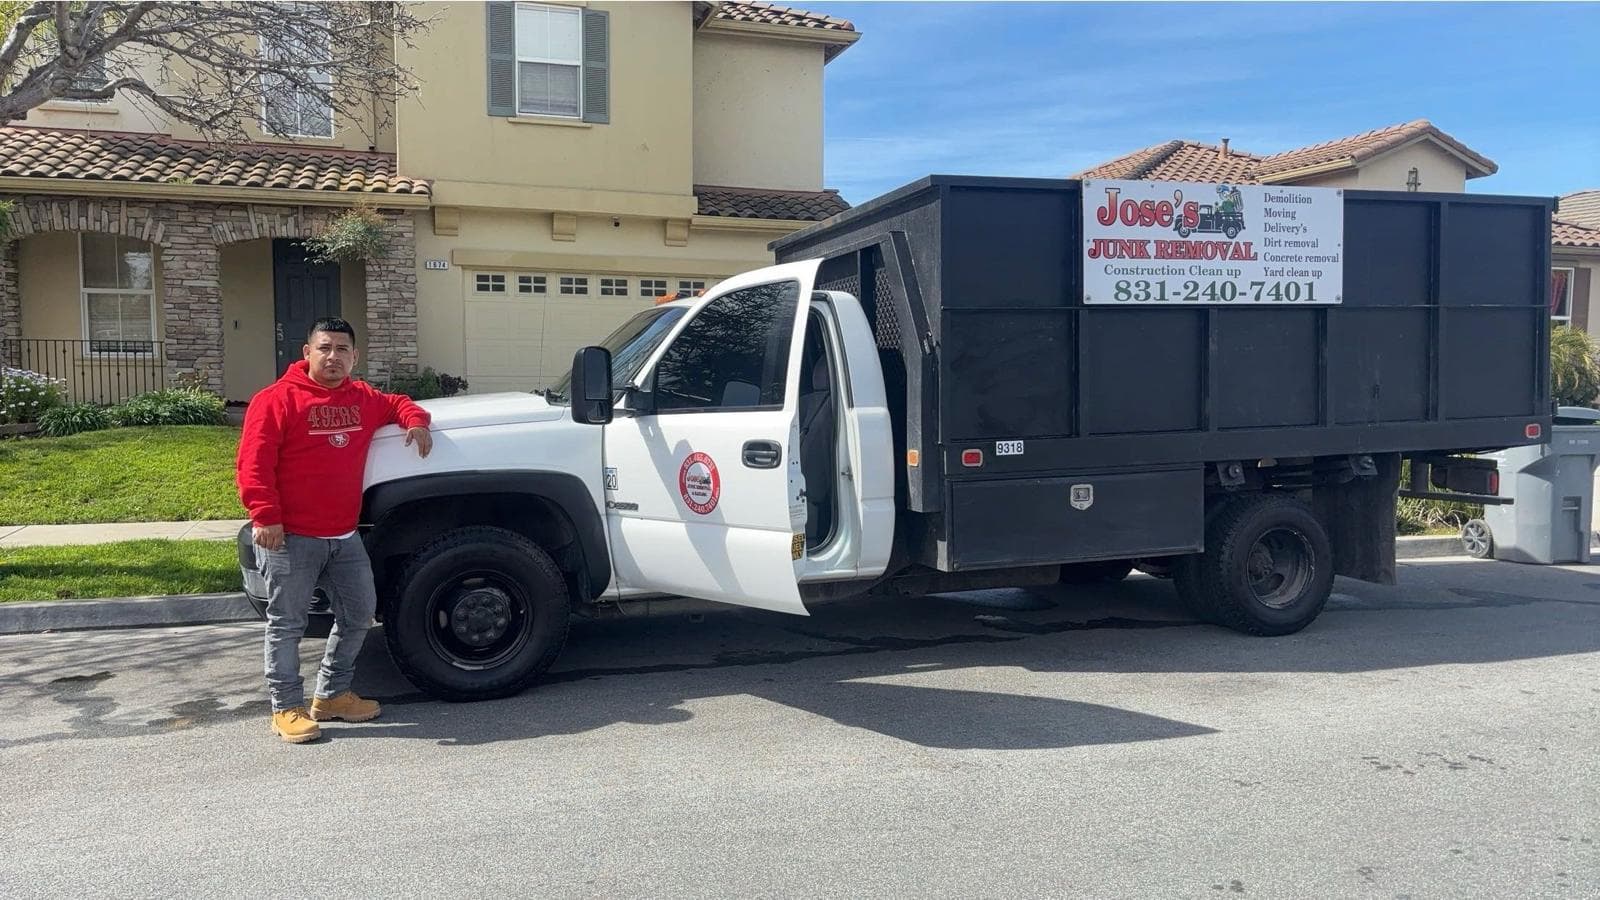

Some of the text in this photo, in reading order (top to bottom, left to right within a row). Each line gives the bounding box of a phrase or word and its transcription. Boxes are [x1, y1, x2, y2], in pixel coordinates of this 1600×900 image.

[1264, 193, 1312, 204] Demolition
[1097, 188, 1200, 228] Jose's
[1264, 208, 1297, 220] Moving
[1264, 222, 1307, 235] Delivery's
[1264, 237, 1319, 248] Dirt removal
[1088, 239, 1258, 261] JUNK REMOVAL
[1264, 252, 1339, 263] Concrete removal
[1104, 264, 1241, 278] Construction Clean up
[1264, 267, 1323, 279] Yard clean up
[1113, 280, 1318, 302] 831-240-7401
[308, 405, 361, 427] 49ERS
[997, 442, 1023, 454] 9318
[607, 474, 617, 488] 20
